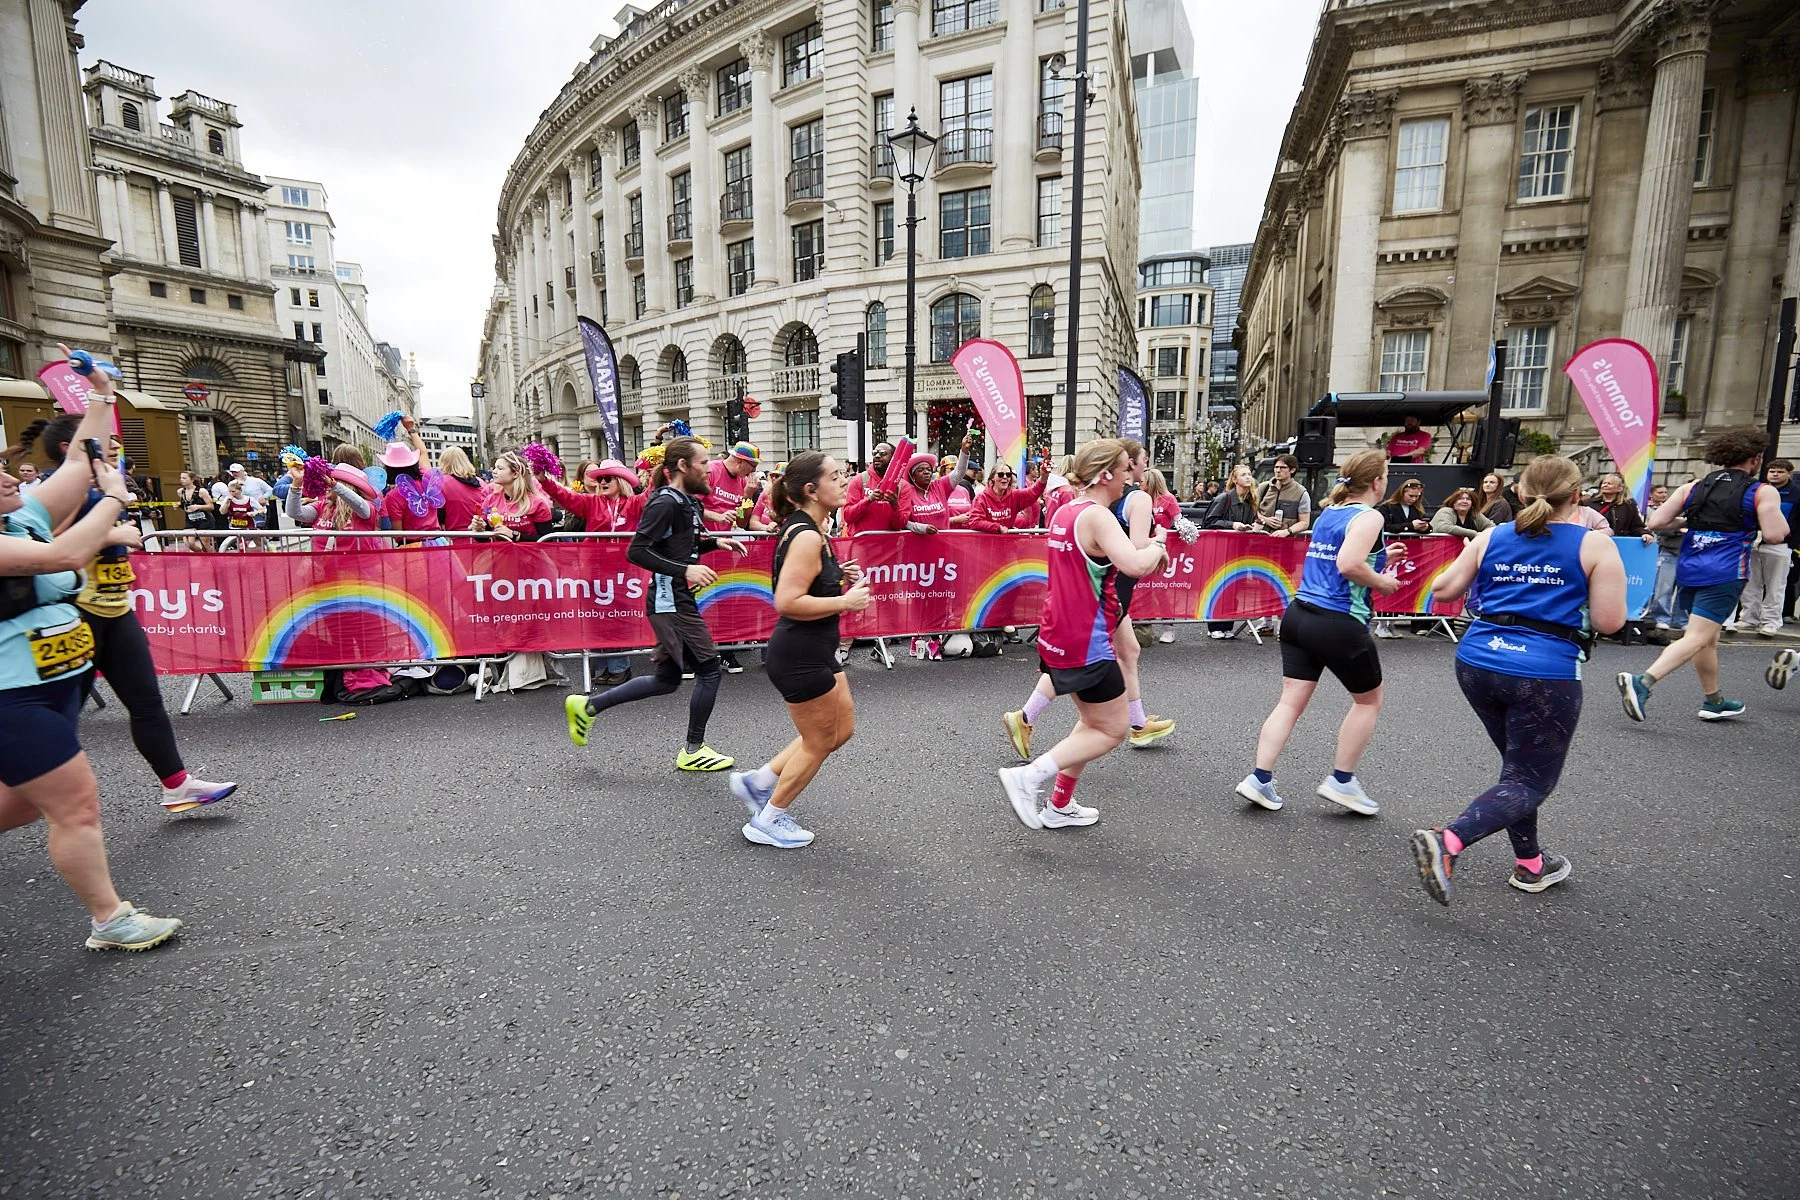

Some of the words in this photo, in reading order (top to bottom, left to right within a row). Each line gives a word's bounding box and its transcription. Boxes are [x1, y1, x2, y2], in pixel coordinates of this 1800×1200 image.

[926, 379, 962, 387] LOMBARD
[858, 558, 958, 587] mmy's
[1494, 563, 1510, 571] We
[1512, 563, 1541, 573] fight
[1543, 564, 1561, 573] for
[1137, 580, 1151, 589] and
[1151, 580, 1169, 590] baby
[1169, 580, 1192, 590] charity
[1527, 575, 1565, 585] health
[466, 572, 643, 606] Tommy's
[888, 590, 904, 600] and
[905, 589, 926, 600] baby
[927, 588, 956, 599] charity
[128, 582, 224, 620] my's
[469, 614, 490, 624] The
[493, 612, 551, 624] pregnancy
[553, 609, 574, 619] and
[577, 608, 605, 620] baby
[607, 608, 644, 619] charity
[179, 624, 226, 636] charity
